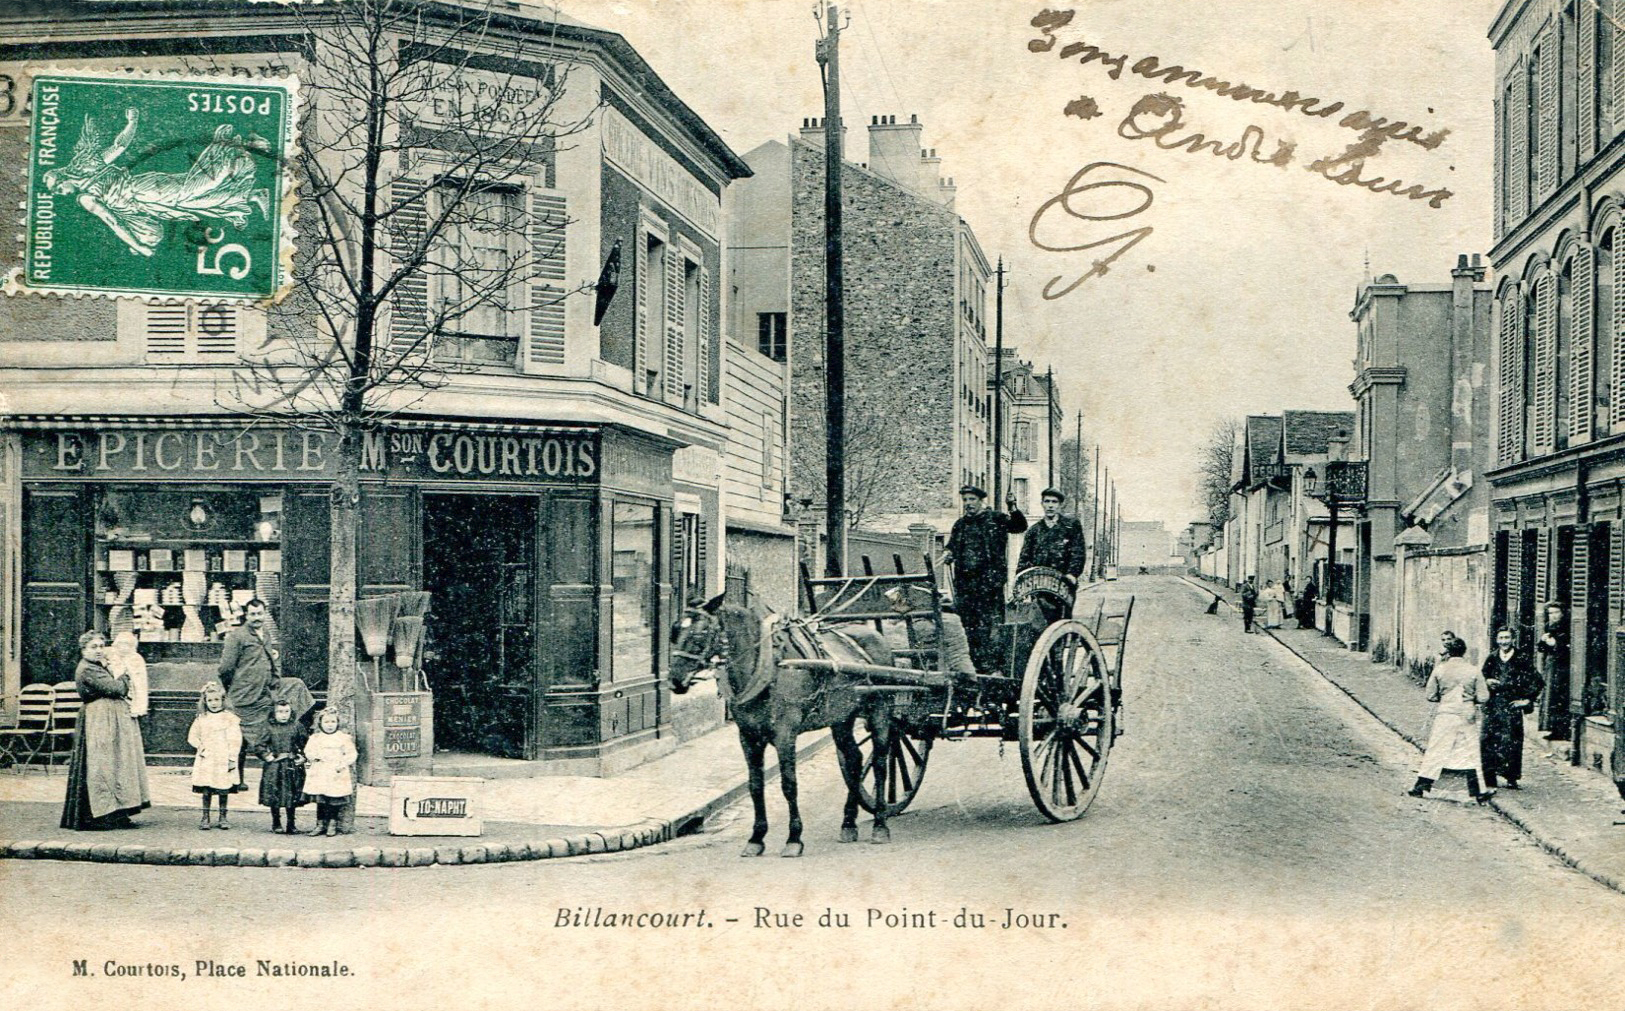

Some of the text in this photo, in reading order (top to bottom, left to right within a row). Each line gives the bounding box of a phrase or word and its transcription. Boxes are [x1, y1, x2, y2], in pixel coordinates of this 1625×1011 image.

[39, 85, 60, 166] FRANÇAISE
[189, 92, 271, 116] POSTES
[33, 191, 55, 280] REPUBLIQUE
[53, 431, 328, 471] EPICERIE
[427, 433, 597, 477] COURTOIS
